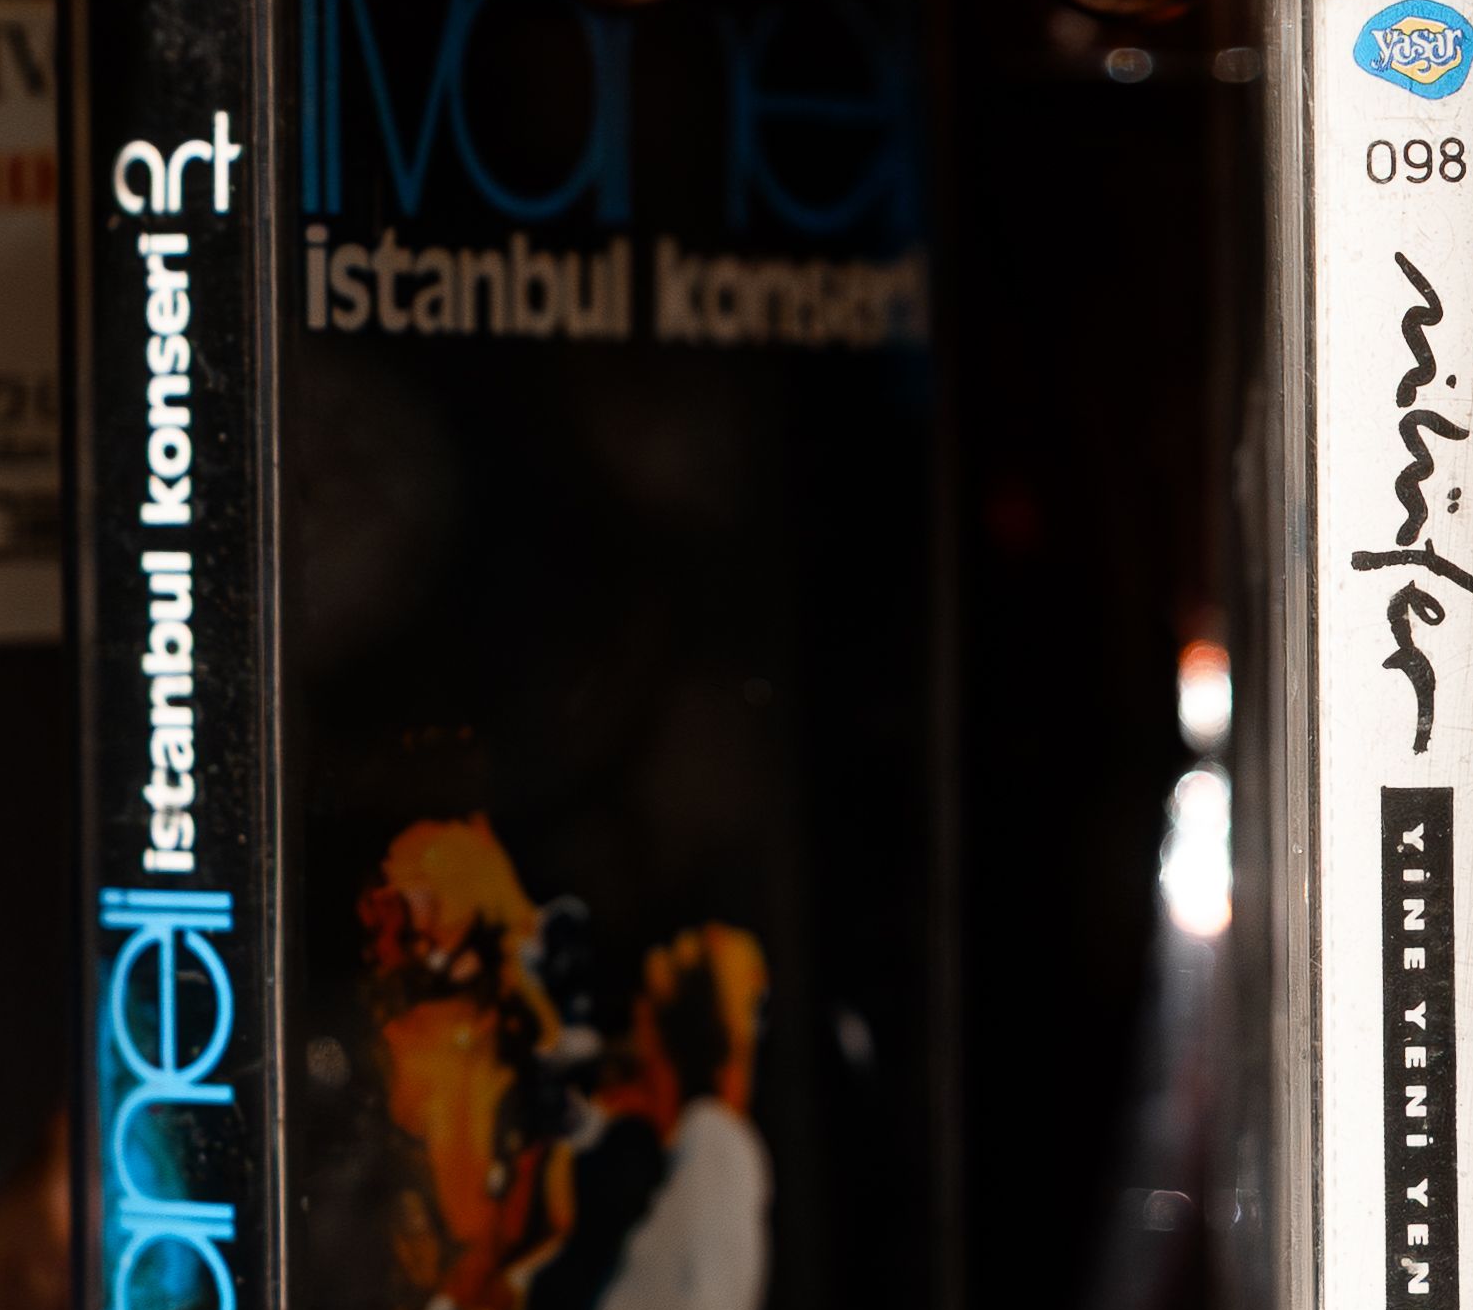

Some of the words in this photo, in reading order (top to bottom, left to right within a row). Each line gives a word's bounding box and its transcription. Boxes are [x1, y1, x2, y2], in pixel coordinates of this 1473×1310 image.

[113, 111, 242, 213] art
[1367, 137, 1466, 183] 098
[302, 222, 633, 339] istanbul
[140, 233, 192, 524] konseri
[140, 551, 195, 873] istanbul
[1402, 823, 1430, 970] YİNE
[1404, 1000, 1434, 1147] YENİ
